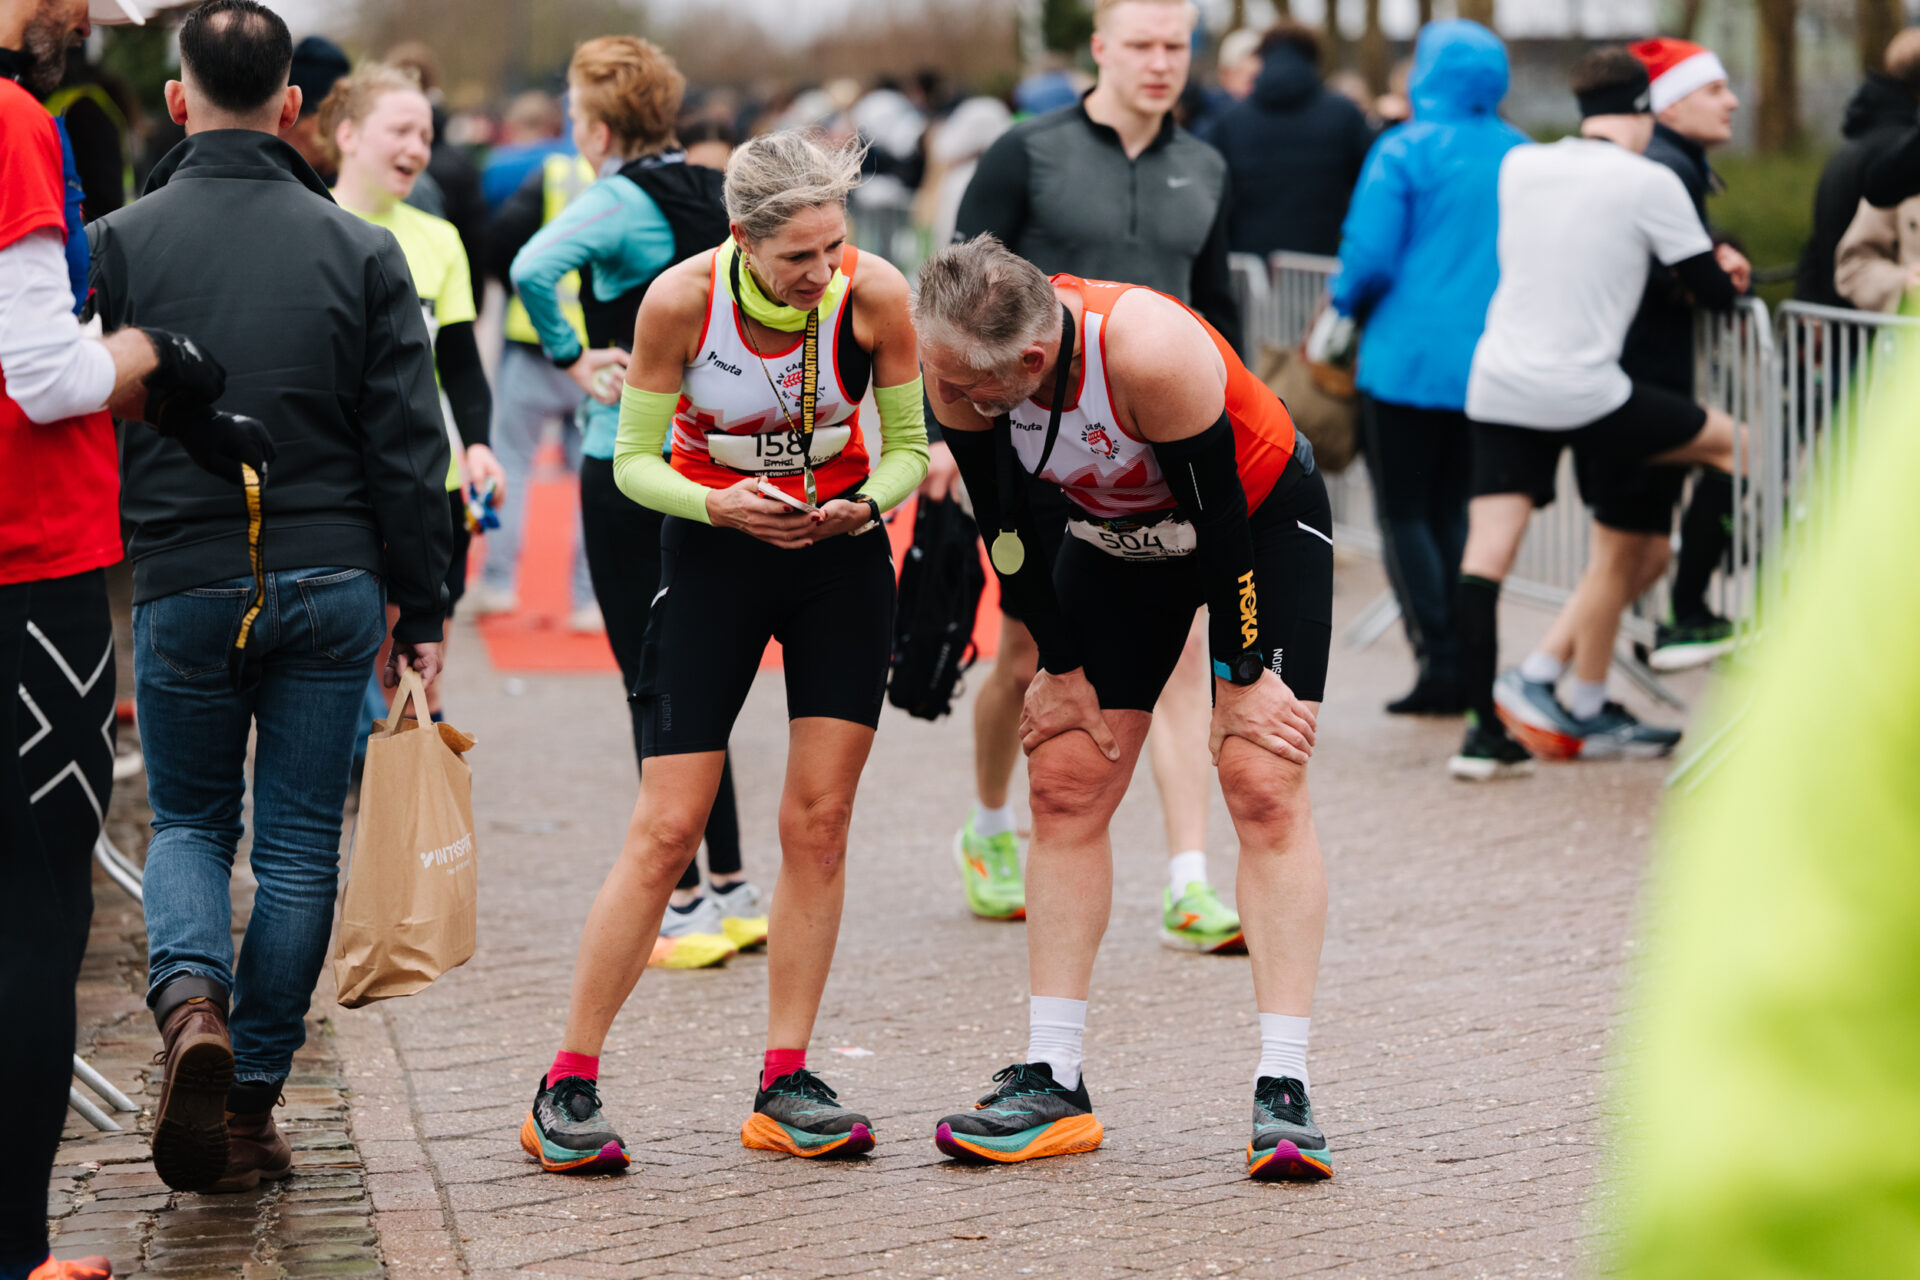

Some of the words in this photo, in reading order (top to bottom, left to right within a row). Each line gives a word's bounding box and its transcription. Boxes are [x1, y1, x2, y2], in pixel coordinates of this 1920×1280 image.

[713, 360, 742, 376] muta
[804, 338, 817, 393] MARATHON
[803, 395, 815, 434] WINTER
[1016, 422, 1042, 431] muta
[751, 431, 803, 457] 158
[1099, 532, 1164, 550] 504
[1238, 569, 1258, 649] HOKA
[1272, 648, 1283, 676] SION
